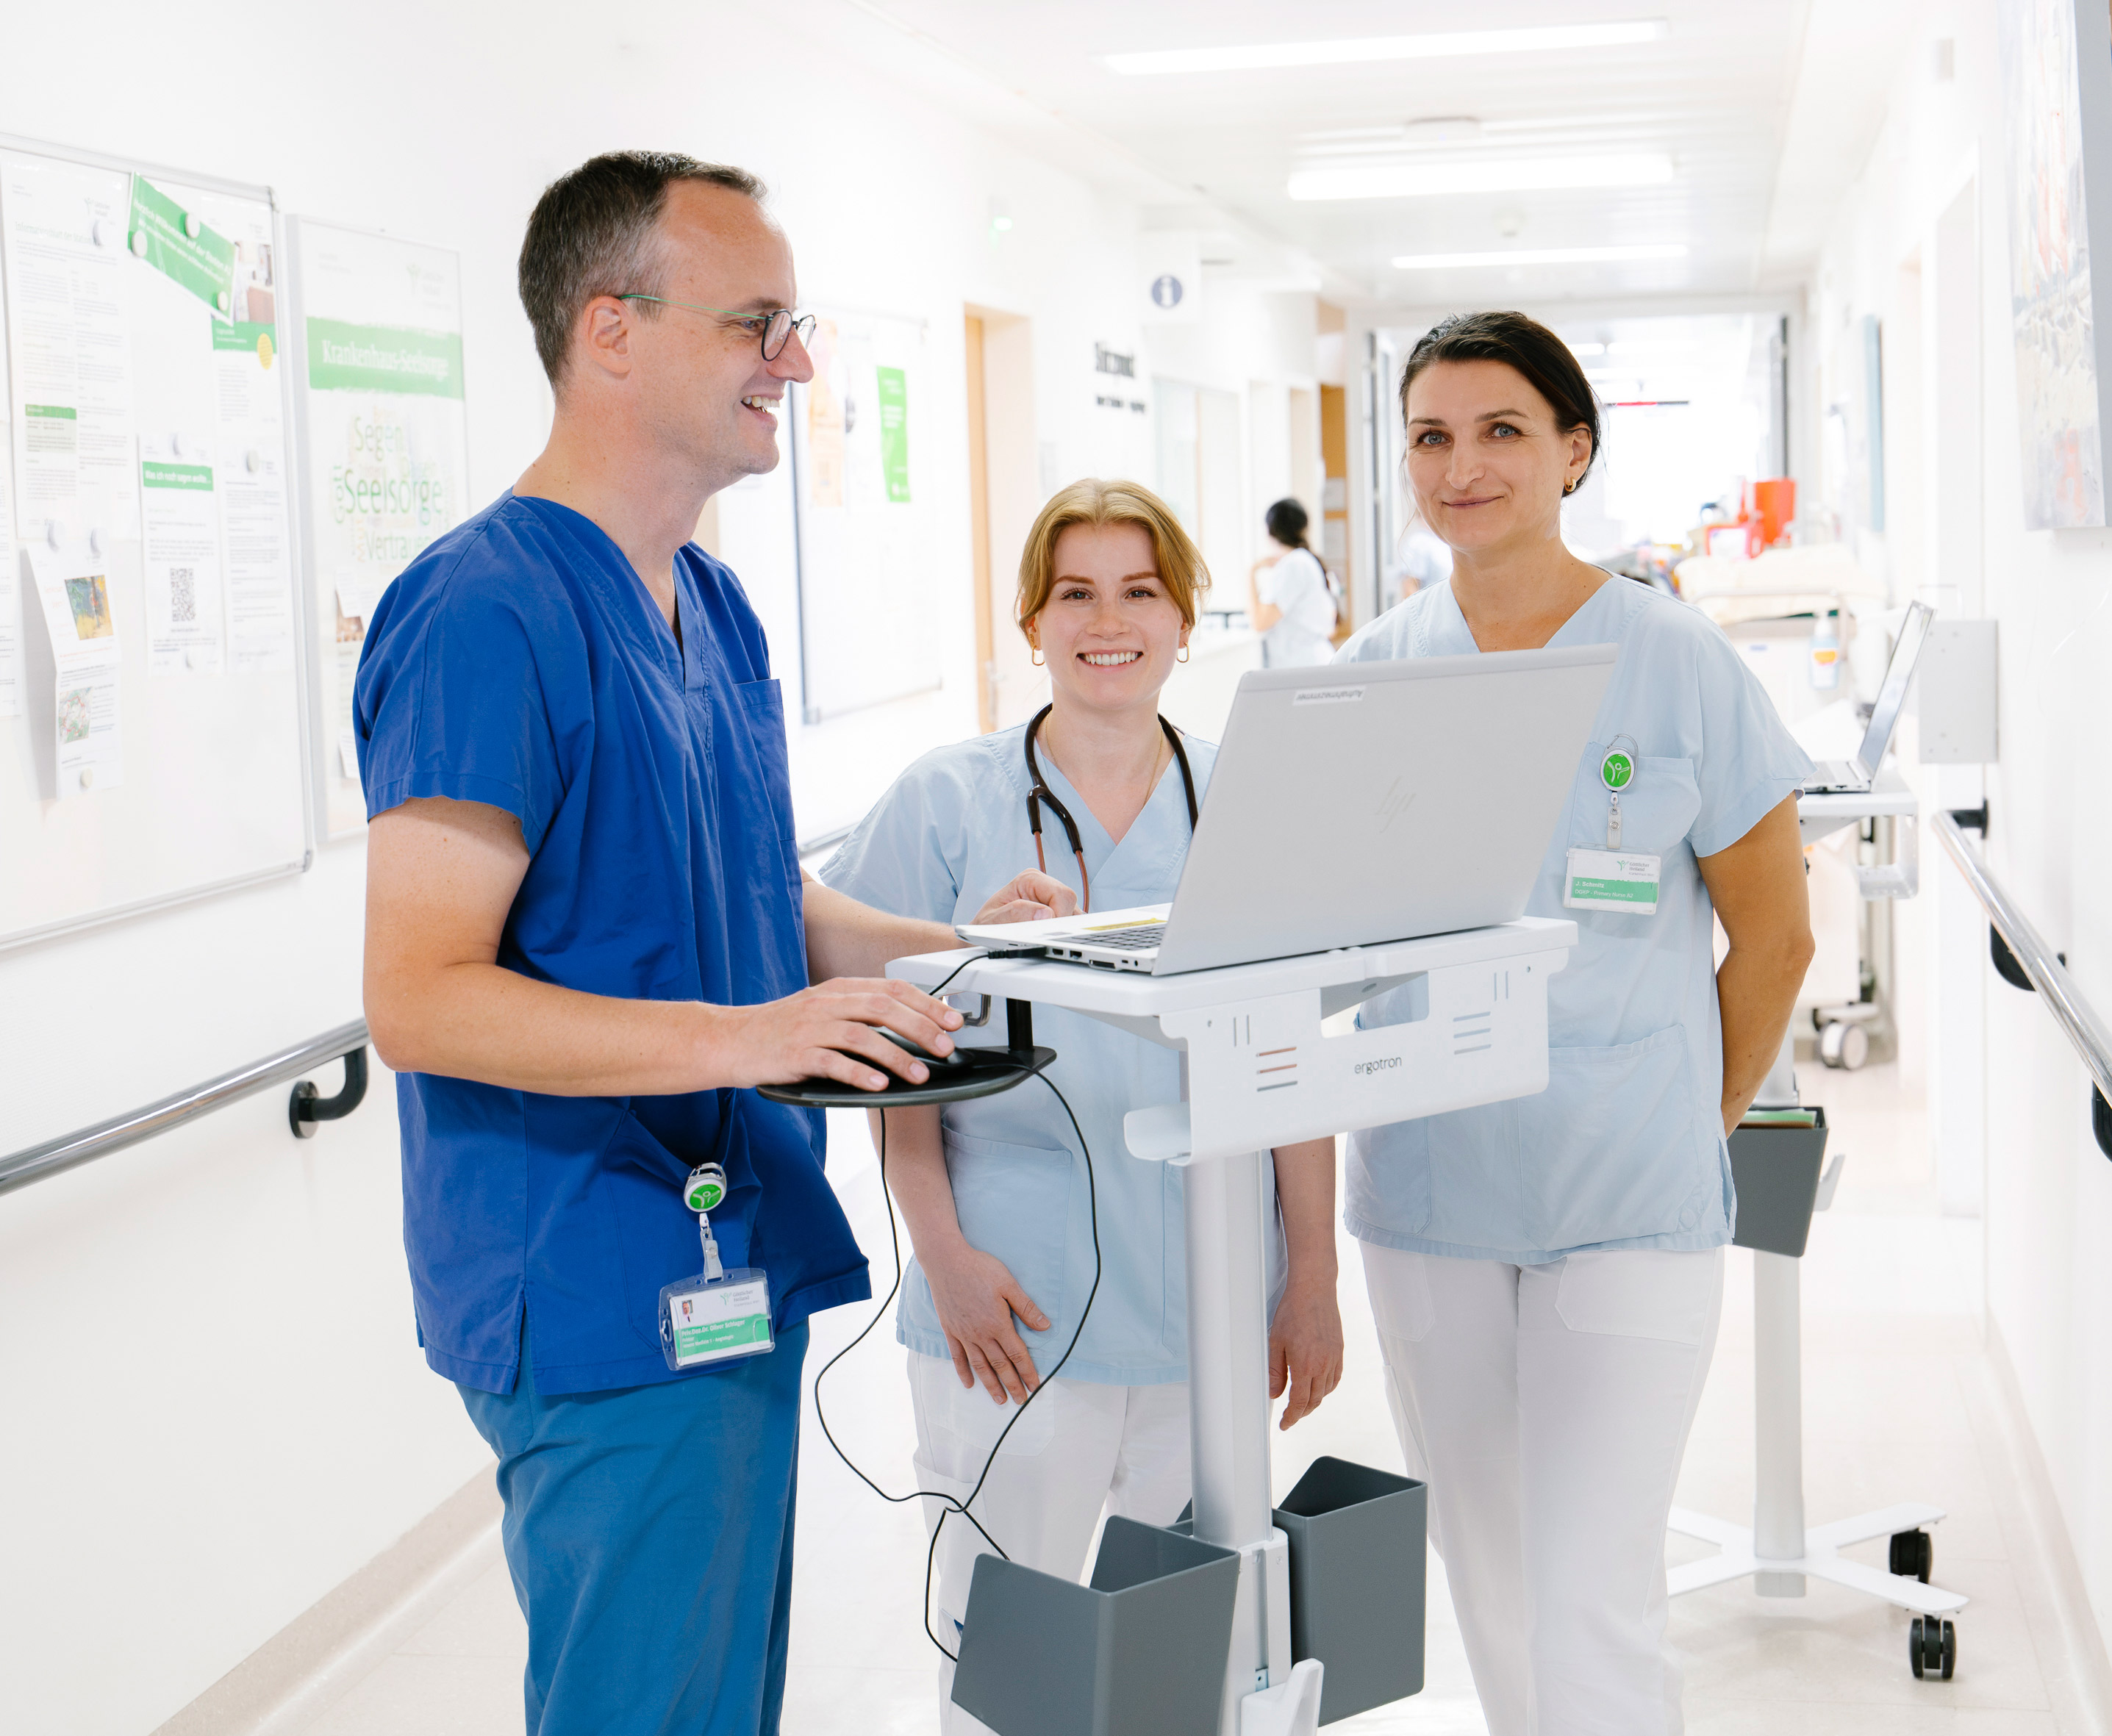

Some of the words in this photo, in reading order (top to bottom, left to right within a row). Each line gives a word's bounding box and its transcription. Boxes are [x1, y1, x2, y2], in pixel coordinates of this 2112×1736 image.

[187, 237, 196, 252] auf
[196, 243, 206, 258] der
[322, 340, 448, 382] Krankenhaus-Seelsorge
[354, 416, 404, 462] Segen
[344, 468, 443, 526] Seelsorge
[1354, 1057, 1402, 1075] ergotron
